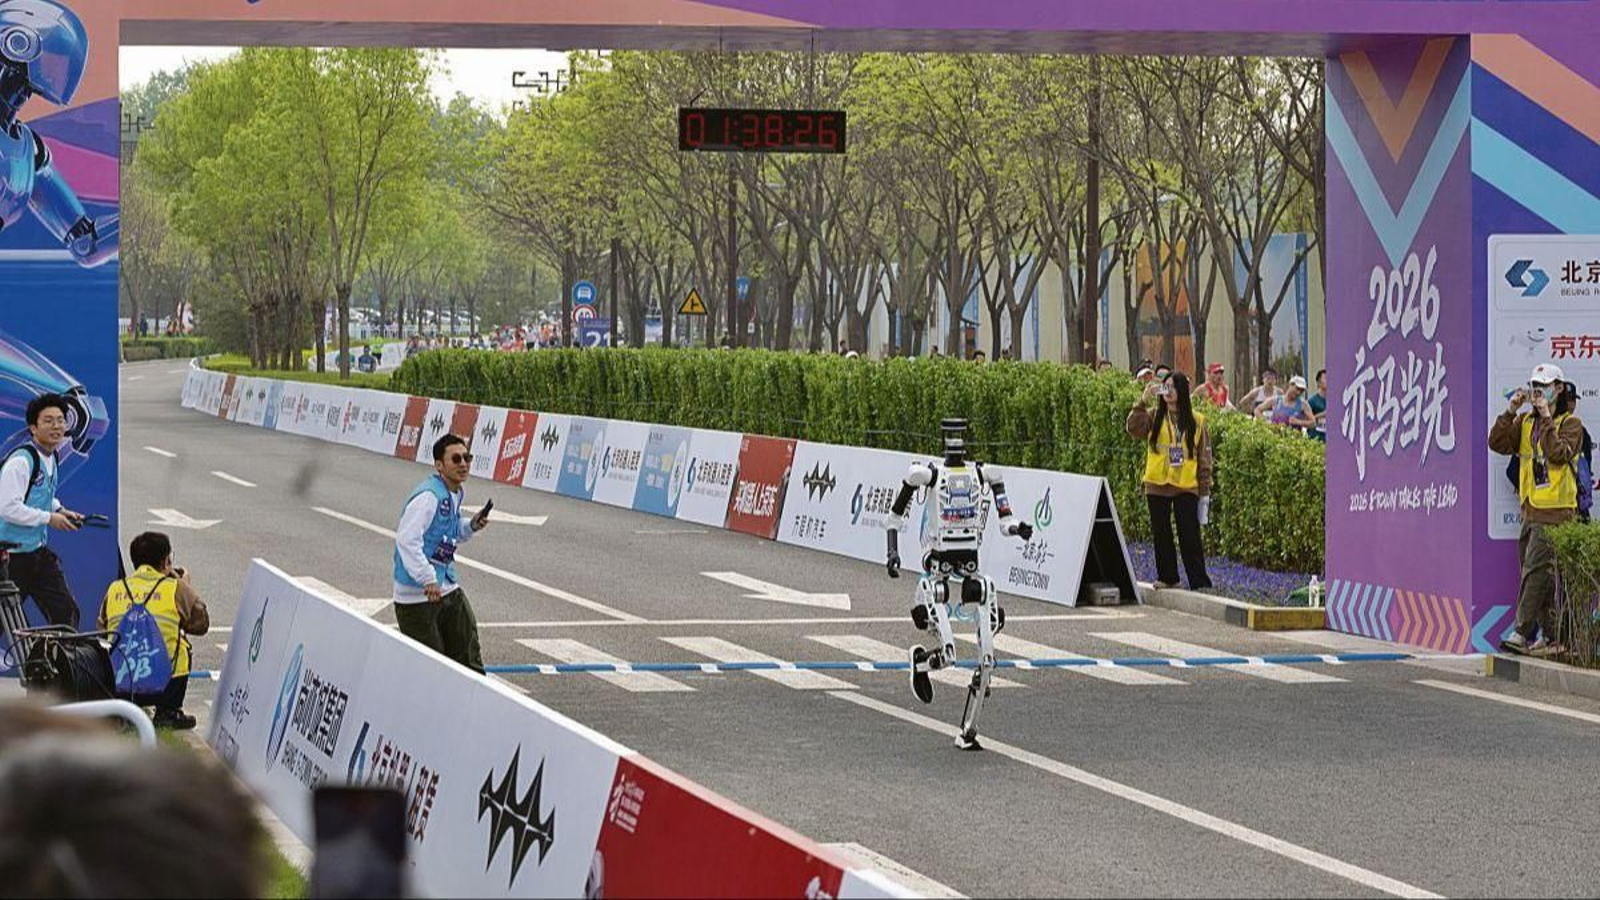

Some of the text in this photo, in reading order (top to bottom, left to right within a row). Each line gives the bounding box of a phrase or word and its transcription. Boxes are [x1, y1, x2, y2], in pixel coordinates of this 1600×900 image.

[686, 114, 837, 148] 01:38:26
[1367, 245, 1440, 350] 2026
[1550, 335, 1600, 359] 京东
[1341, 343, 1455, 481] 亦马当先
